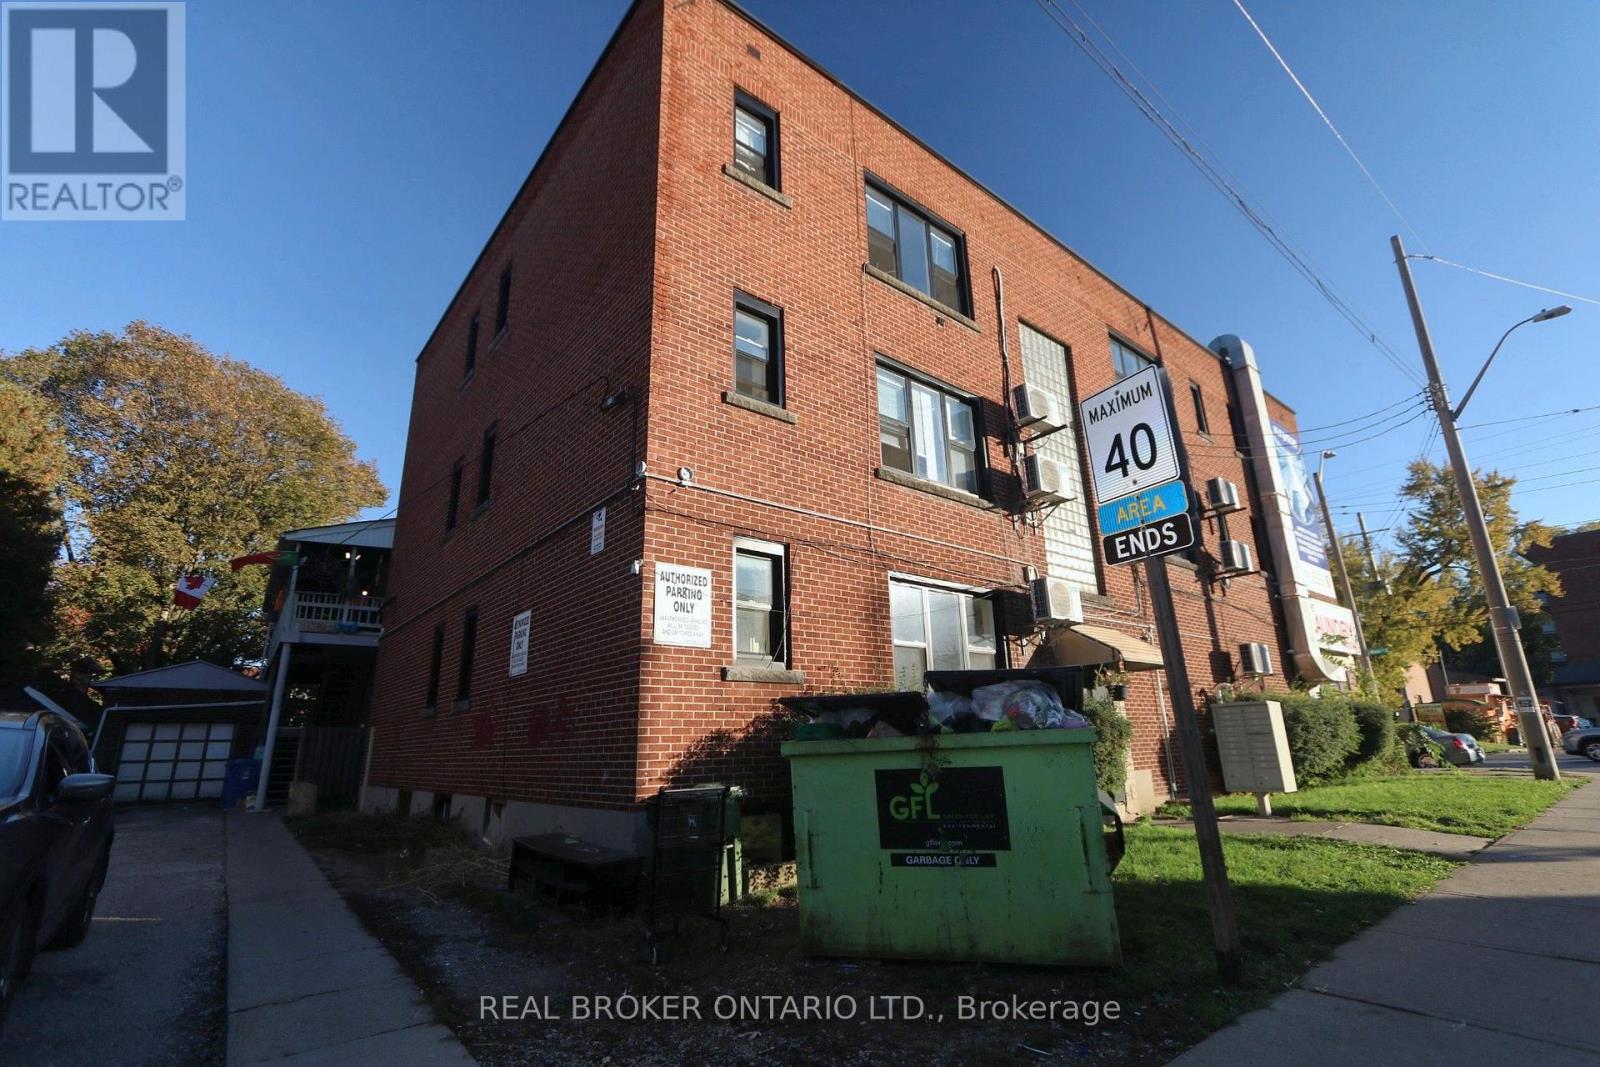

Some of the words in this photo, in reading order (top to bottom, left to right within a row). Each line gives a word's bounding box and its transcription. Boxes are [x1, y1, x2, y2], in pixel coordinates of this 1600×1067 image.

[1088, 381, 1153, 425] MAXIMUM
[1105, 422, 1157, 478] 40
[1116, 495, 1166, 524] AREA
[1114, 522, 1178, 559] ENDS
[660, 571, 708, 587] AUTHORIZED
[666, 586, 702, 600] PARKING
[673, 601, 695, 613] ONLY
[889, 782, 941, 820] GFL
[905, 855, 952, 865] GARBAGE
[954, 856, 980, 865] OLY
